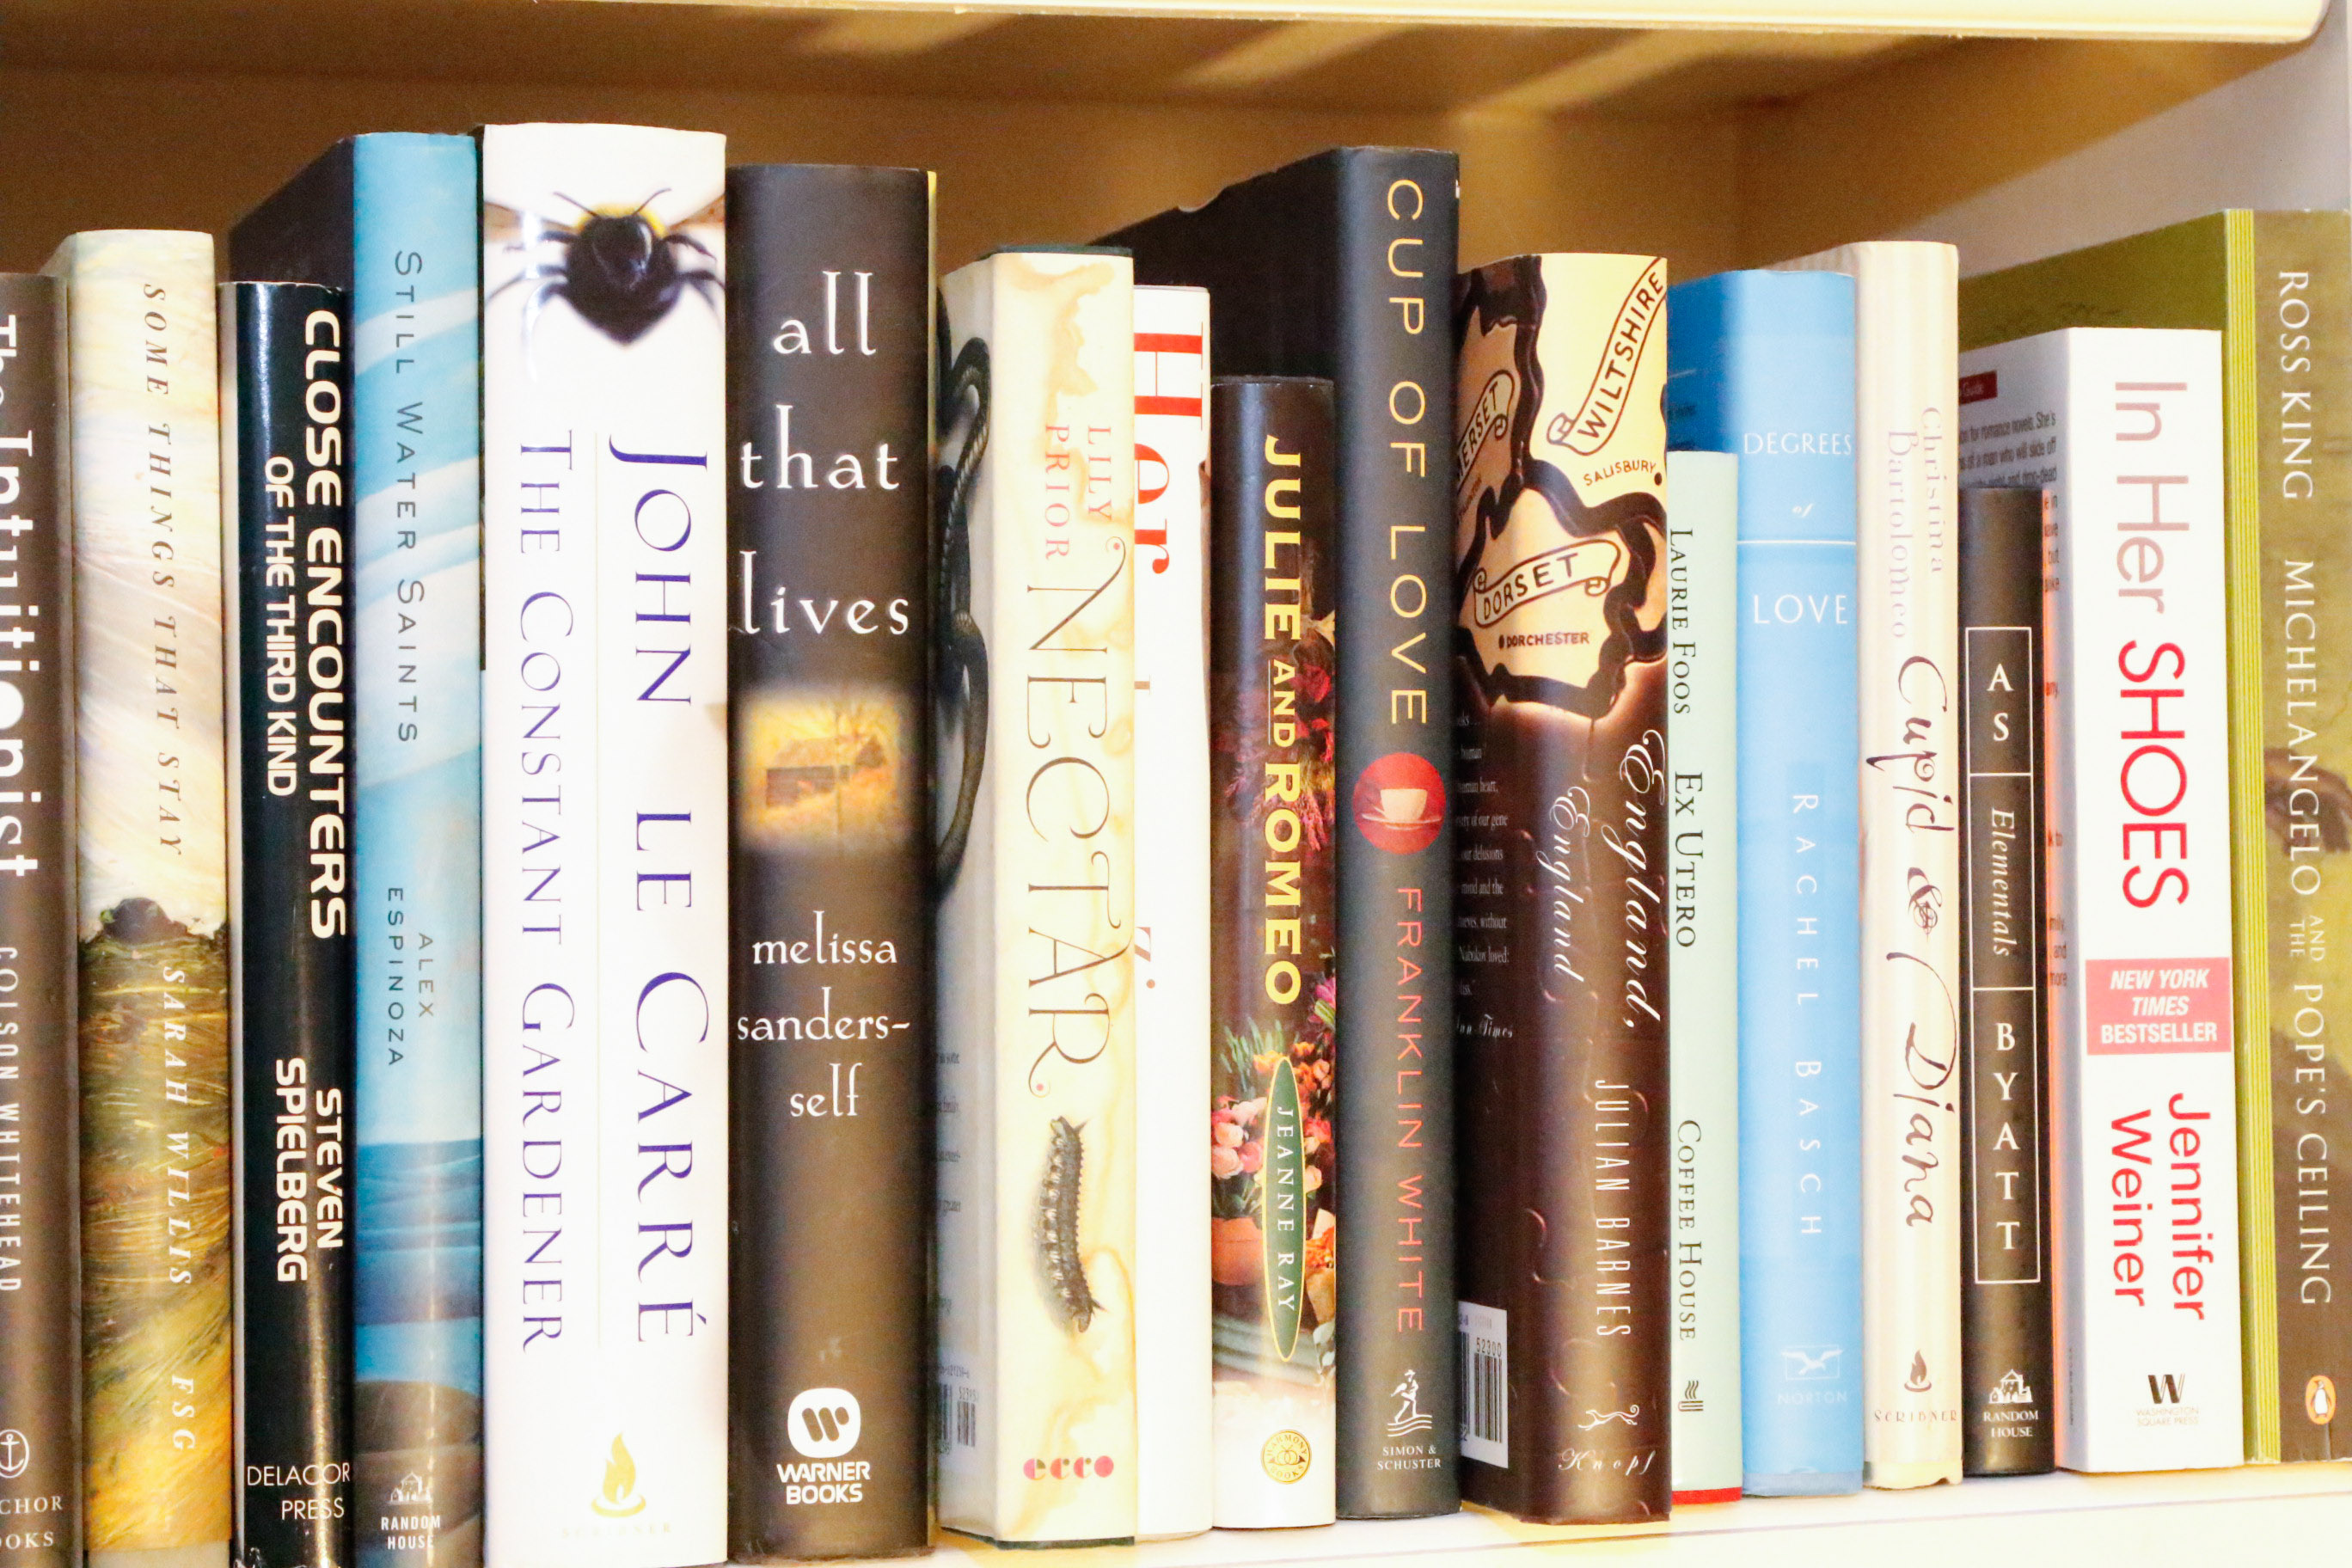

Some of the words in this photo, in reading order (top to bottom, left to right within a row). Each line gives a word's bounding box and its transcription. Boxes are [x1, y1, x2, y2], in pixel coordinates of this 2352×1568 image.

[395, 251, 423, 375] STILL
[773, 271, 877, 356] all
[1387, 180, 1424, 335] CUP
[143, 283, 168, 395] SOME
[1577, 272, 1664, 439] WILTSHIRE
[2279, 272, 2310, 372] ROSS
[304, 309, 341, 507] CLOSE
[741, 405, 900, 491] that
[1389, 381, 1426, 478] OF
[1460, 381, 1499, 478] ERSET
[1743, 432, 1853, 456] DEGREES
[2115, 382, 2188, 442] In
[2282, 390, 2312, 499] KING
[147, 422, 176, 587] THINGS
[266, 456, 297, 509] OF
[395, 401, 424, 551] WATER
[520, 429, 573, 554] THE
[1044, 425, 1070, 560] PRIOR
[1087, 425, 1112, 522] LILY
[1583, 460, 1657, 487] SALISBURY
[1921, 407, 1947, 573] Christina
[266, 517, 297, 588] THE
[609, 432, 708, 704] JOHN
[739, 550, 910, 634] lives
[1265, 434, 1302, 640] JULIE
[1482, 553, 1579, 622] DORSET
[1670, 528, 1694, 630] LAURIE
[2116, 475, 2190, 615] Her
[266, 599, 297, 713] THIRD
[397, 579, 426, 743] SAINTS
[1390, 525, 1427, 725] LOVE
[1506, 631, 1590, 647] DORCHESTER
[1753, 594, 1849, 625] LOVE
[152, 615, 180, 726] THAT
[1273, 658, 1296, 748] AND
[1673, 640, 1696, 715] FOOS
[266, 714, 298, 797] KIND
[306, 527, 346, 940] ENCOUNTERS
[520, 591, 574, 945] CONSTANT
[1866, 655, 1956, 834] Cupid
[2118, 640, 2190, 909] SHOES
[2284, 560, 2322, 897] MICHELANGELO
[157, 750, 183, 855] STAY
[1026, 536, 1133, 1099] NECTAR
[1675, 771, 1703, 818] EX
[636, 809, 692, 912] LE
[1265, 762, 1302, 1005] ROMEO
[1535, 786, 1591, 983] England
[1601, 729, 1666, 1029] England,
[1675, 830, 1704, 948] UTERO
[1792, 793, 1819, 1006] RACHEL
[1991, 807, 2018, 958] Elementals
[388, 886, 404, 1066] ESPINOZA
[418, 932, 434, 1018] ALEX
[752, 910, 897, 965] melissa
[2110, 971, 2155, 990] NEW
[2158, 969, 2211, 989] YORK
[2289, 919, 2306, 957] THE
[2309, 914, 2326, 962] AND
[162, 966, 188, 1106] SARAH
[737, 986, 911, 1041] sanders-
[1397, 887, 1423, 1150] FRANKLIN
[2100, 1021, 2219, 1044] BESTSELLER
[2131, 995, 2191, 1017] TIMES
[2294, 984, 2327, 1115] POPE'S
[790, 1063, 863, 1117] self
[1595, 1079, 1630, 1191] JULIAN
[1885, 952, 1957, 1226] Diana
[1993, 1022, 2021, 1251] BYATT
[0, 1102, 21, 1291] WHITEHEAD
[276, 1057, 308, 1283] SPIELBERG
[315, 1087, 343, 1249] STEVEN
[522, 982, 575, 1353] GARDENER
[636, 971, 709, 1342] CARRÉ
[1277, 1106, 1295, 1233] JEANNE
[1677, 1118, 1702, 1231] COFFEE
[1795, 1059, 1822, 1235] BASCH
[166, 1131, 193, 1285] WILLIS
[1398, 1174, 1424, 1332] WHITE
[2110, 1108, 2153, 1308] Weiner
[2168, 1092, 2214, 1321] Jennifer
[2297, 1132, 2332, 1304] CEILING
[1277, 1252, 1295, 1312] RAY
[1596, 1216, 1632, 1338] BARNES
[1679, 1241, 1703, 1342] HOUSE
[1382, 1445, 1424, 1456] SIMON
[1428, 1444, 1437, 1455] &
[1777, 1390, 1847, 1406] NORTON
[1982, 1410, 2039, 1422] RANDOM
[1991, 1426, 2034, 1438] HOUSE
[0, 1495, 63, 1515] CHOR
[281, 1497, 344, 1520] PRESS
[776, 1461, 871, 1483] WARNER
[786, 1483, 863, 1504] BOOKS
[1377, 1458, 1442, 1471] SCHUSTER
[1558, 1449, 1657, 1476] Knopf
[0, 1531, 54, 1550] OKS
[380, 1515, 441, 1531] RANDOM
[387, 1535, 434, 1550] HOUSE
